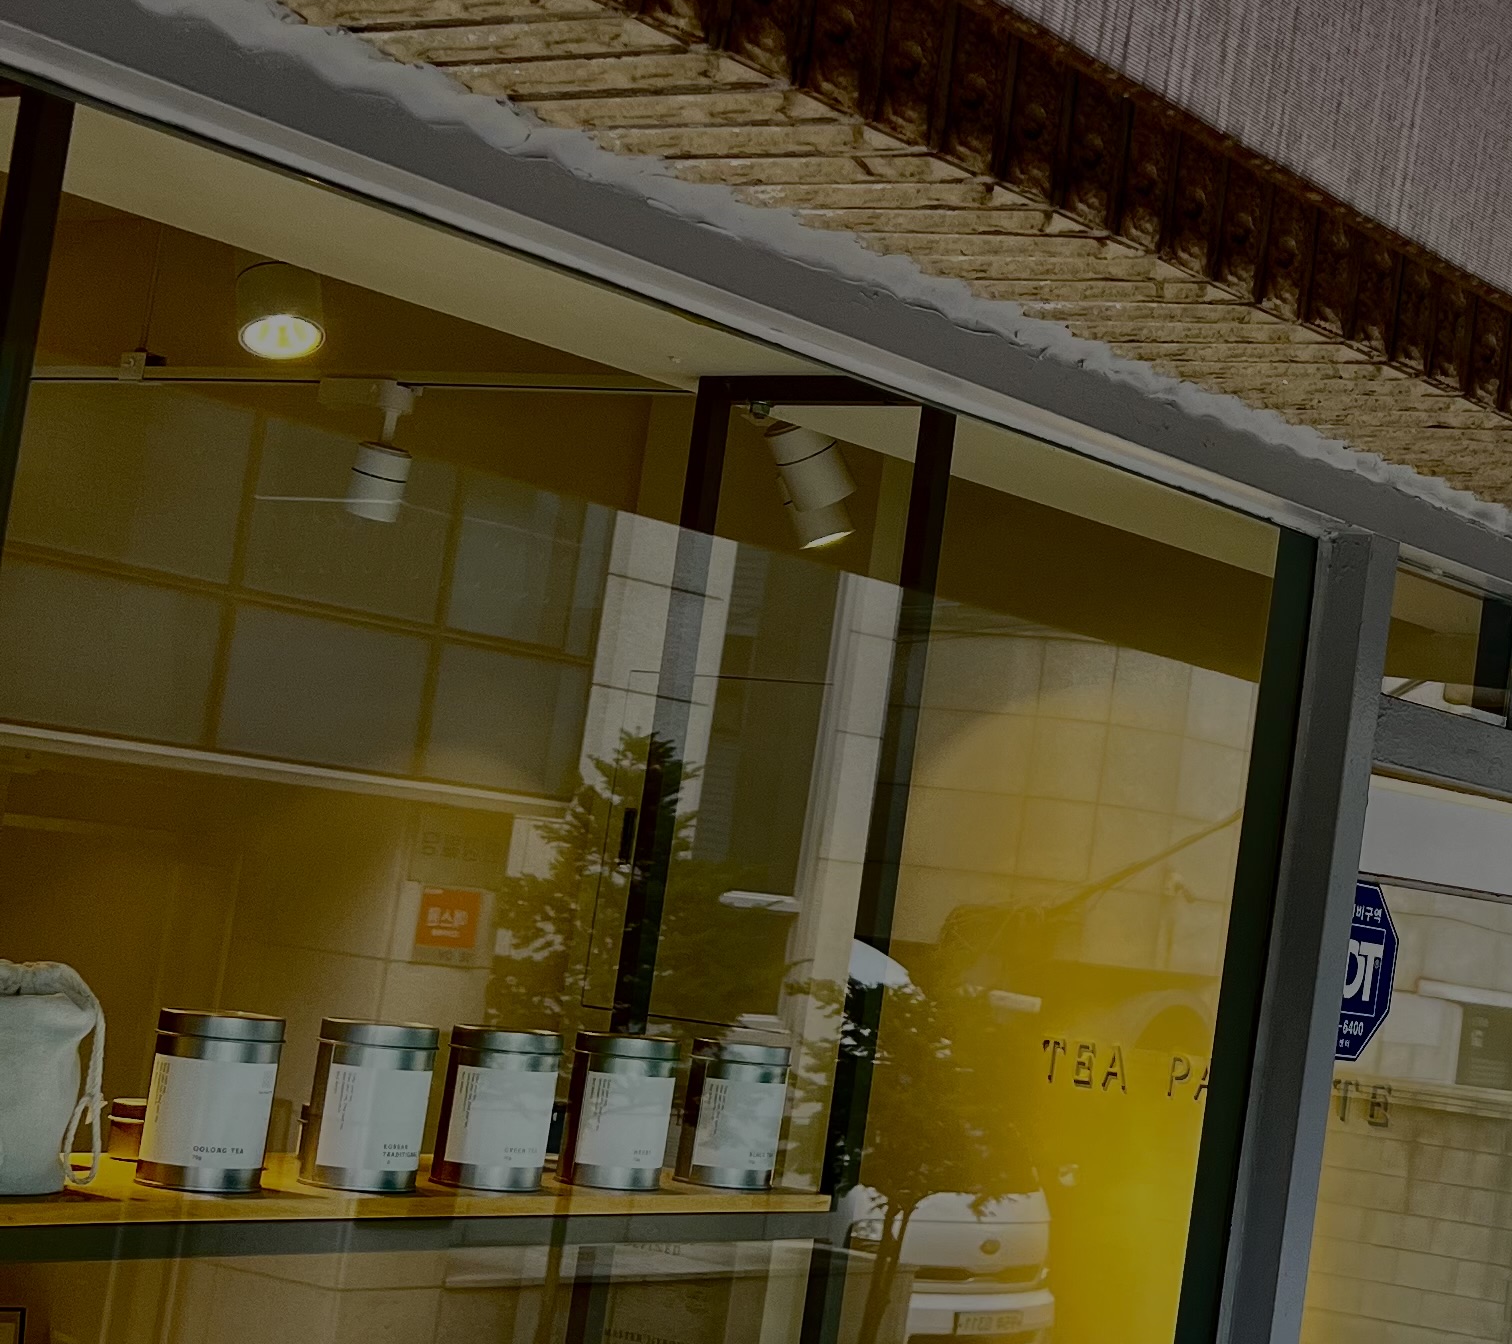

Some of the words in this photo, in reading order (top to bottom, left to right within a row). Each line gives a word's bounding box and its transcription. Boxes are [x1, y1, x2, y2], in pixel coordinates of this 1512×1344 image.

[1353, 904, 1383, 924] 비구역
[1042, 1039, 1127, 1094] TEA
[193, 1145, 227, 1154] OOLONG
